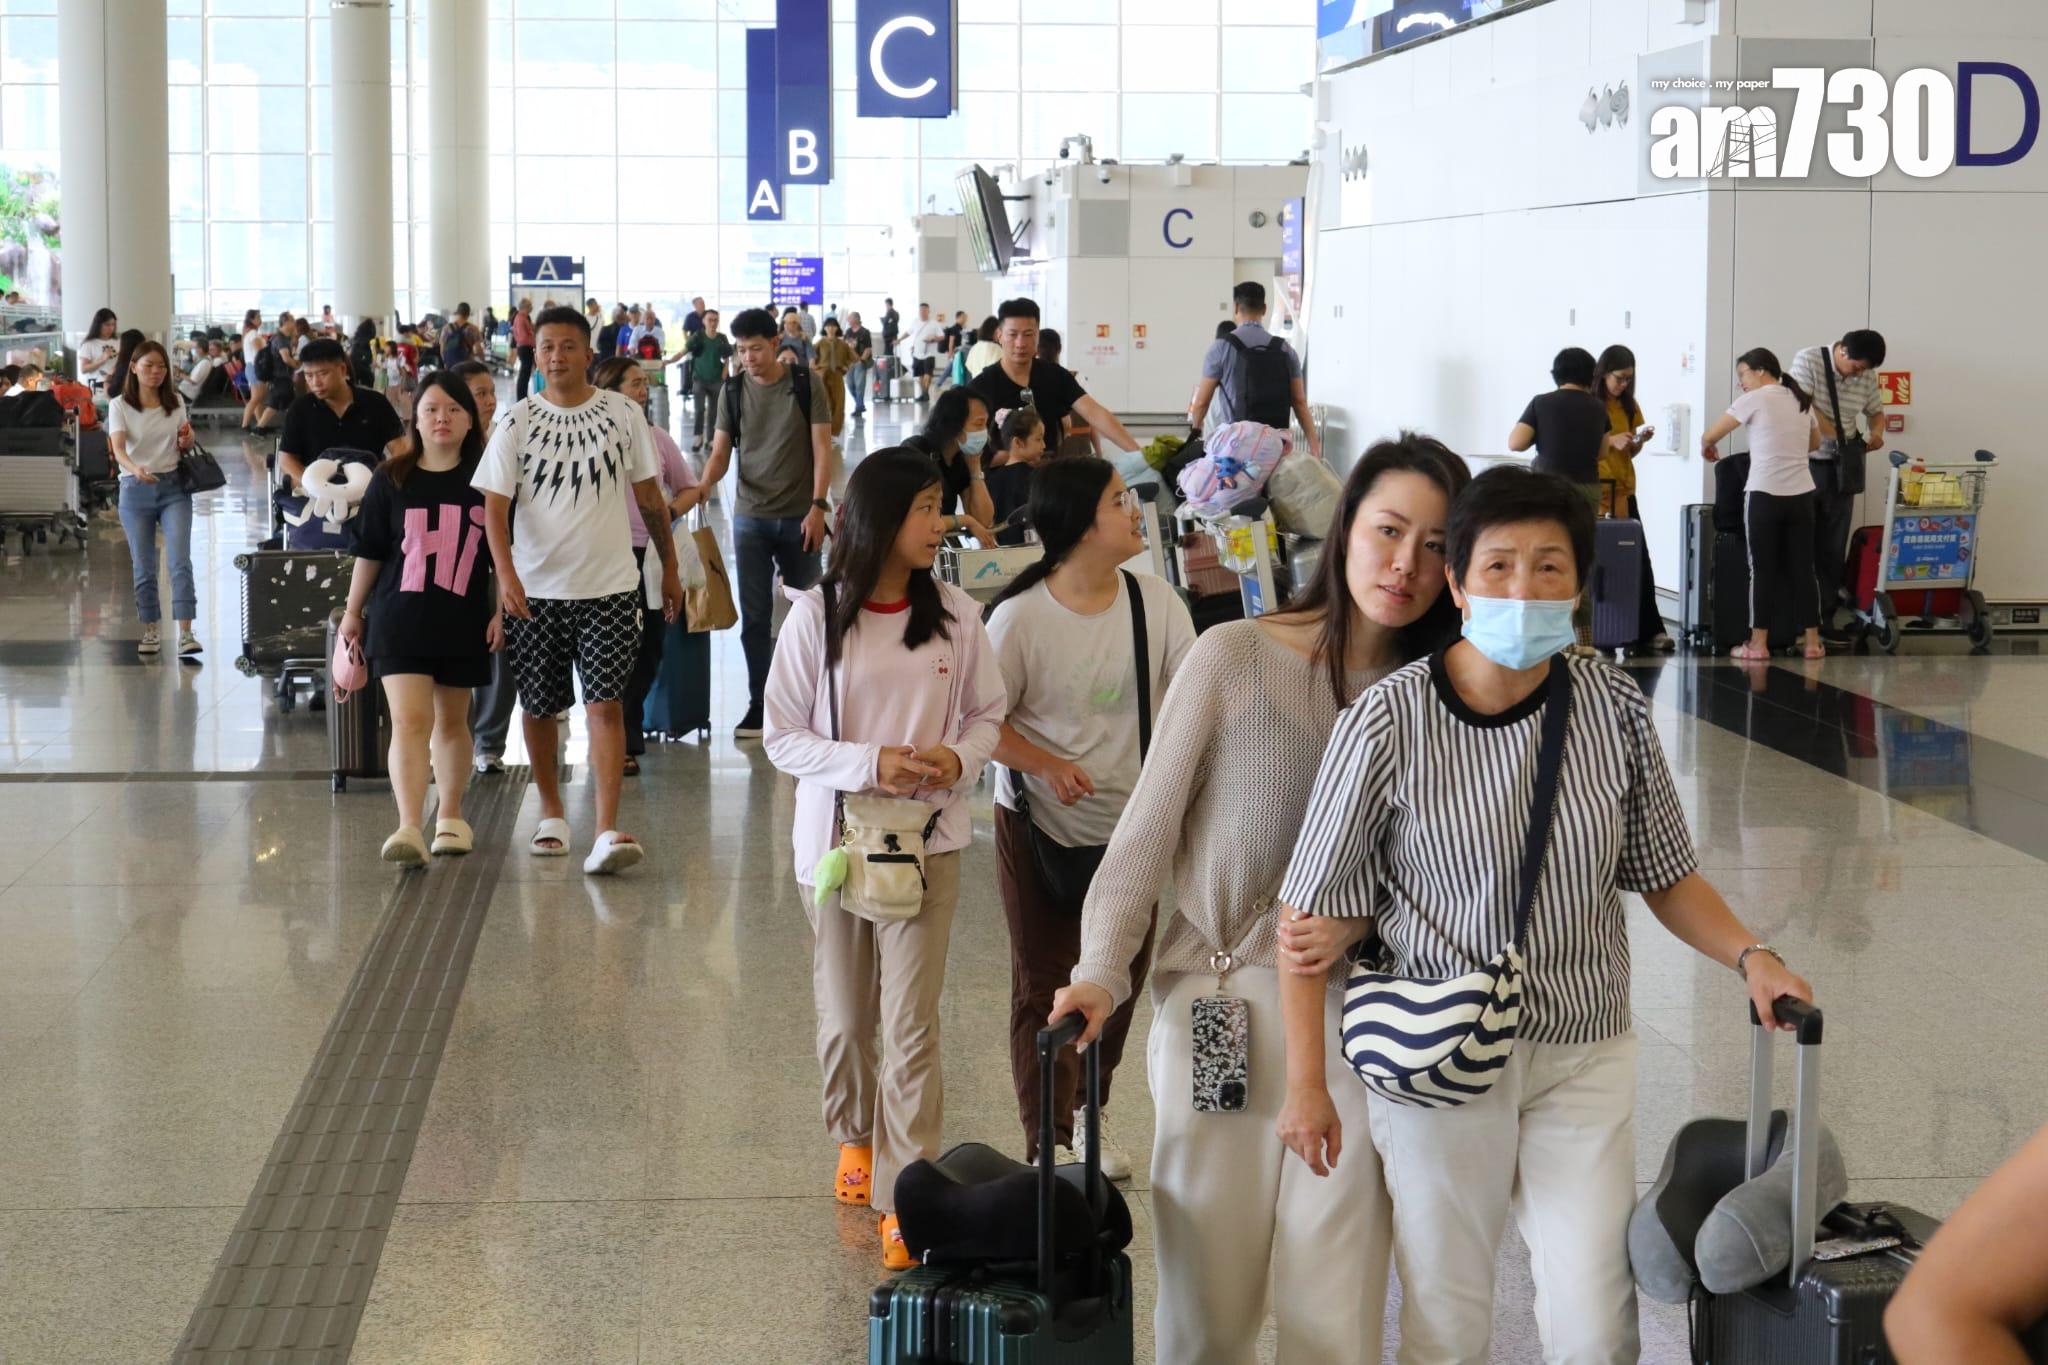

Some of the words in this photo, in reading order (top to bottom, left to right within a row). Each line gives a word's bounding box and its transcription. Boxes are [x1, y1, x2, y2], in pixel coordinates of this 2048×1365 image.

[870, 16, 937, 98] C
[1955, 61, 2041, 167] D
[788, 129, 819, 176] B
[749, 179, 780, 214] A
[1163, 208, 1193, 248] C
[535, 256, 559, 280] A
[400, 503, 485, 597] Hi
